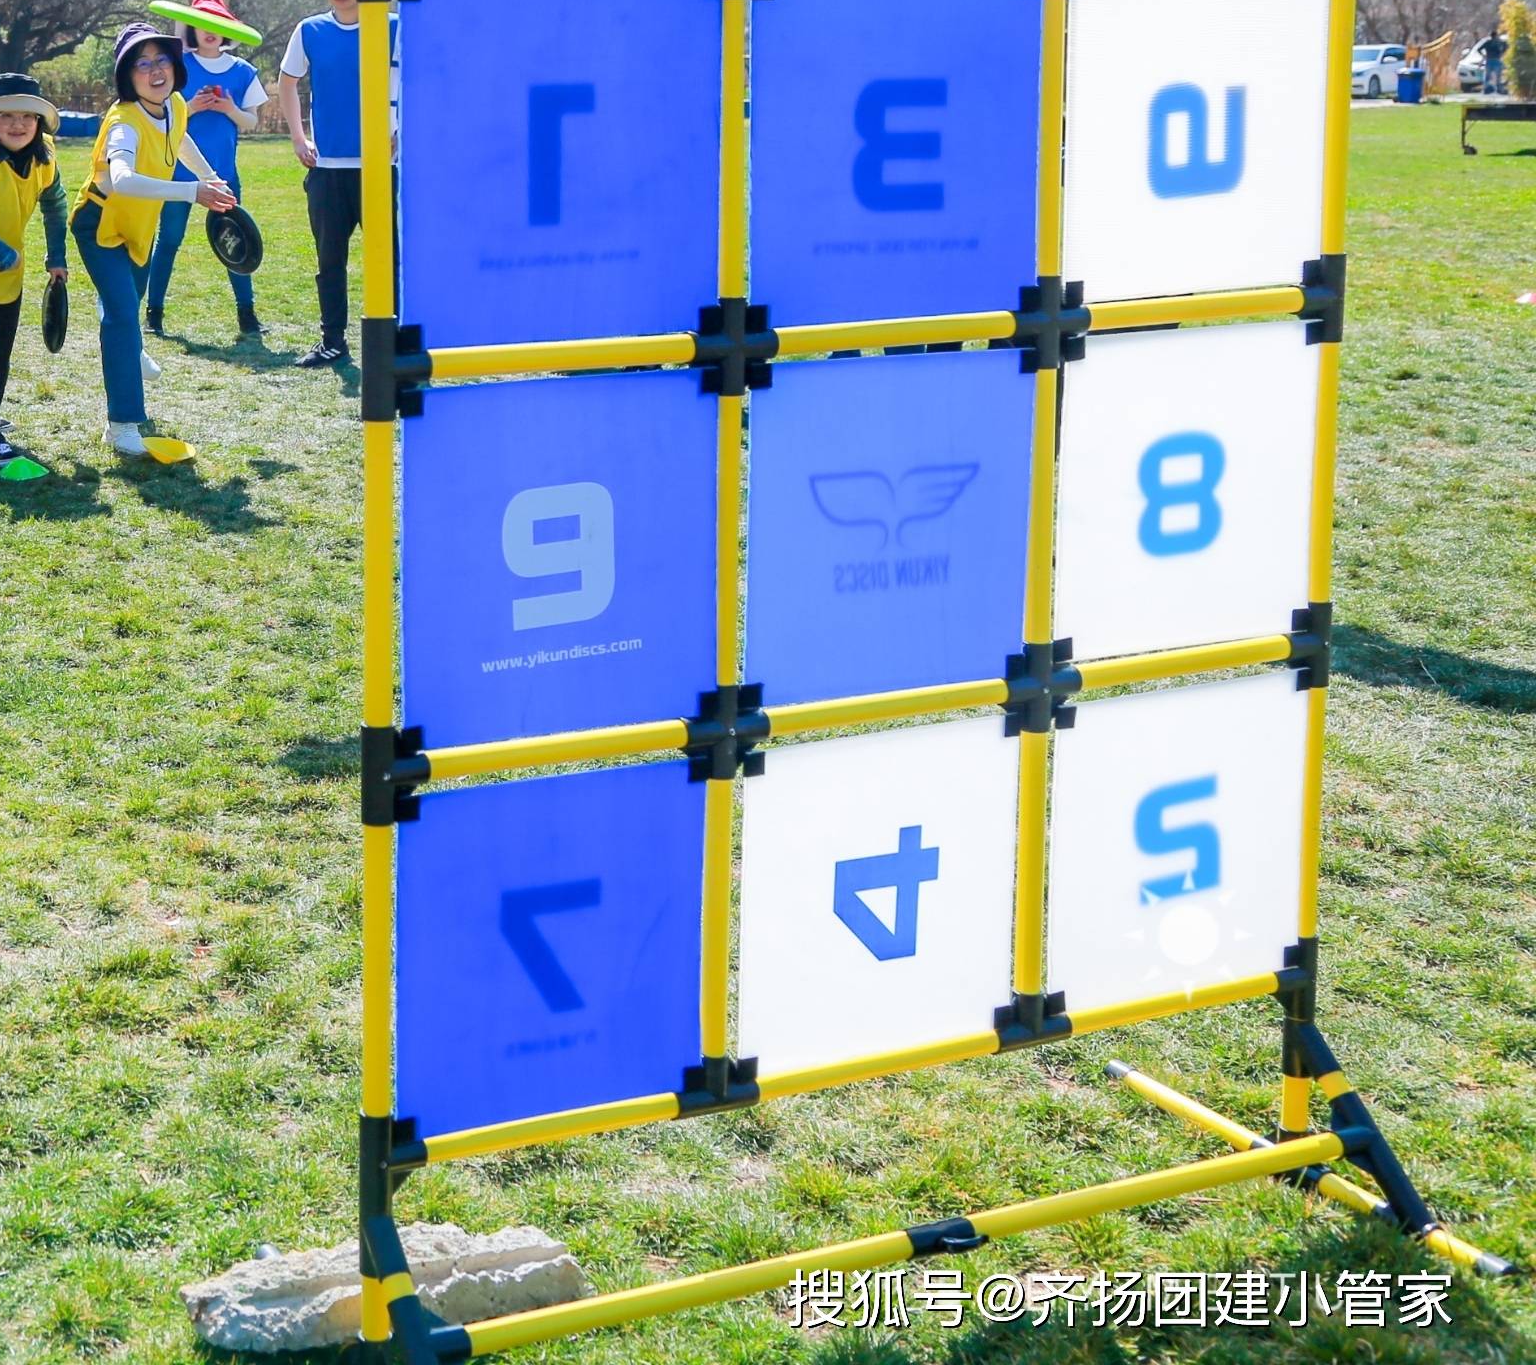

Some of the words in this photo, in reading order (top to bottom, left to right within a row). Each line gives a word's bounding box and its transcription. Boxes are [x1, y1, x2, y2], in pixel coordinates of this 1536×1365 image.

[501, 481, 616, 632] 9
[1136, 430, 1226, 558] 8
[481, 637, 643, 674] www.yikundiscs.com
[833, 824, 940, 962] 4
